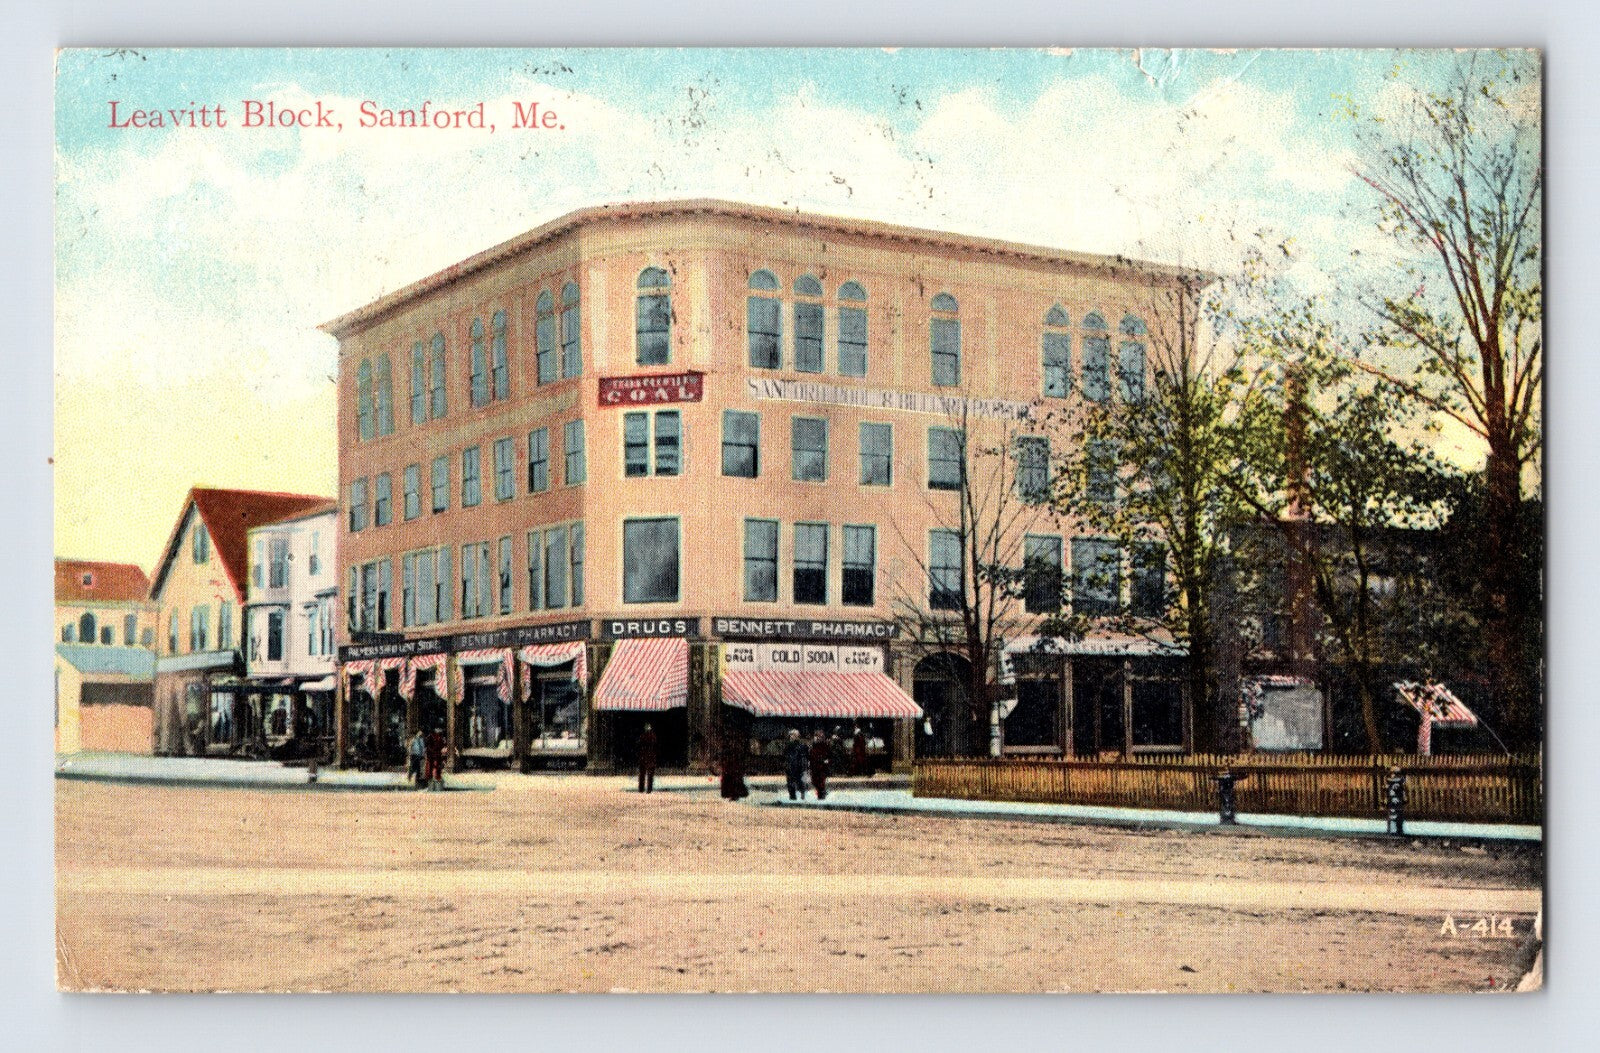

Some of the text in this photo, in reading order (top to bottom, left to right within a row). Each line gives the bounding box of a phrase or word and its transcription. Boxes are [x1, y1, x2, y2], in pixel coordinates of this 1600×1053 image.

[606, 386, 695, 403] COAL
[518, 623, 579, 640] PHARMACY
[611, 620, 687, 635] DRUGS
[716, 619, 895, 637] BENNETT PHARMACY
[771, 650, 835, 664] COLD SODA
